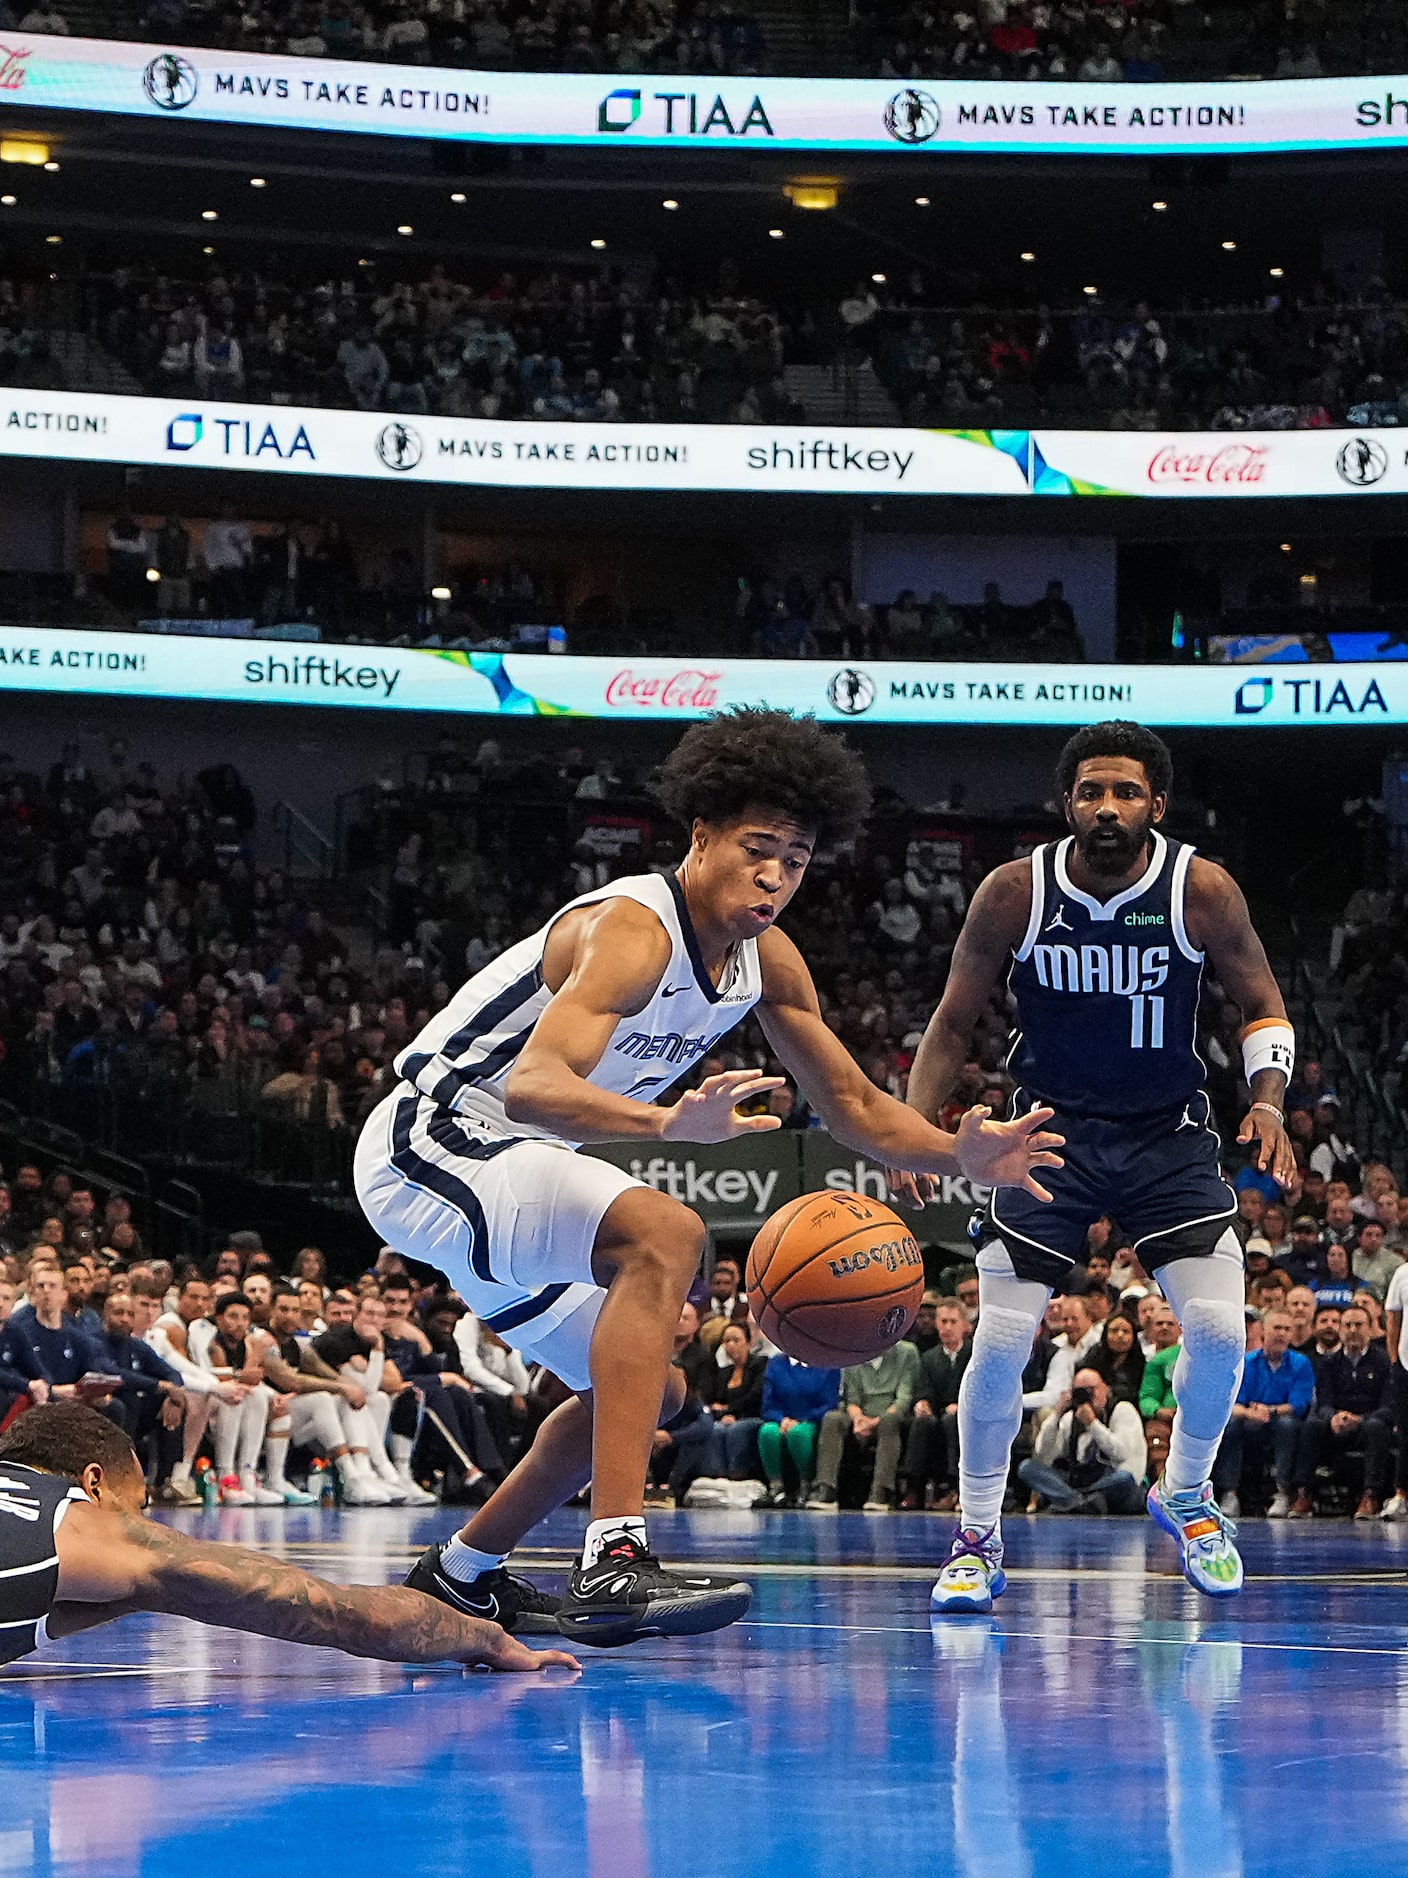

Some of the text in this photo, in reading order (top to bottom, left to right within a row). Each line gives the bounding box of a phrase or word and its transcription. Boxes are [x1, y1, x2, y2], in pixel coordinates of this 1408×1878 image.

[215, 74, 489, 114] MAVS TAKE ACTION!
[655, 93, 775, 136] TIAA
[958, 105, 1244, 127] MAVS TAKE ACTION!
[7, 411, 108, 434] ACTION!
[215, 419, 316, 460] TIAA
[439, 439, 688, 463] MAVS TAKE ACTION!
[748, 440, 914, 480] shiftkey
[50, 650, 146, 672] ACTION!
[244, 656, 400, 697] shiftkey
[890, 681, 1132, 702] MAVS TAKE ACTION!
[1284, 678, 1389, 714] TIAA
[1124, 912, 1165, 926] chime
[1033, 944, 1170, 995] MAVS
[1128, 995, 1164, 1048] 11
